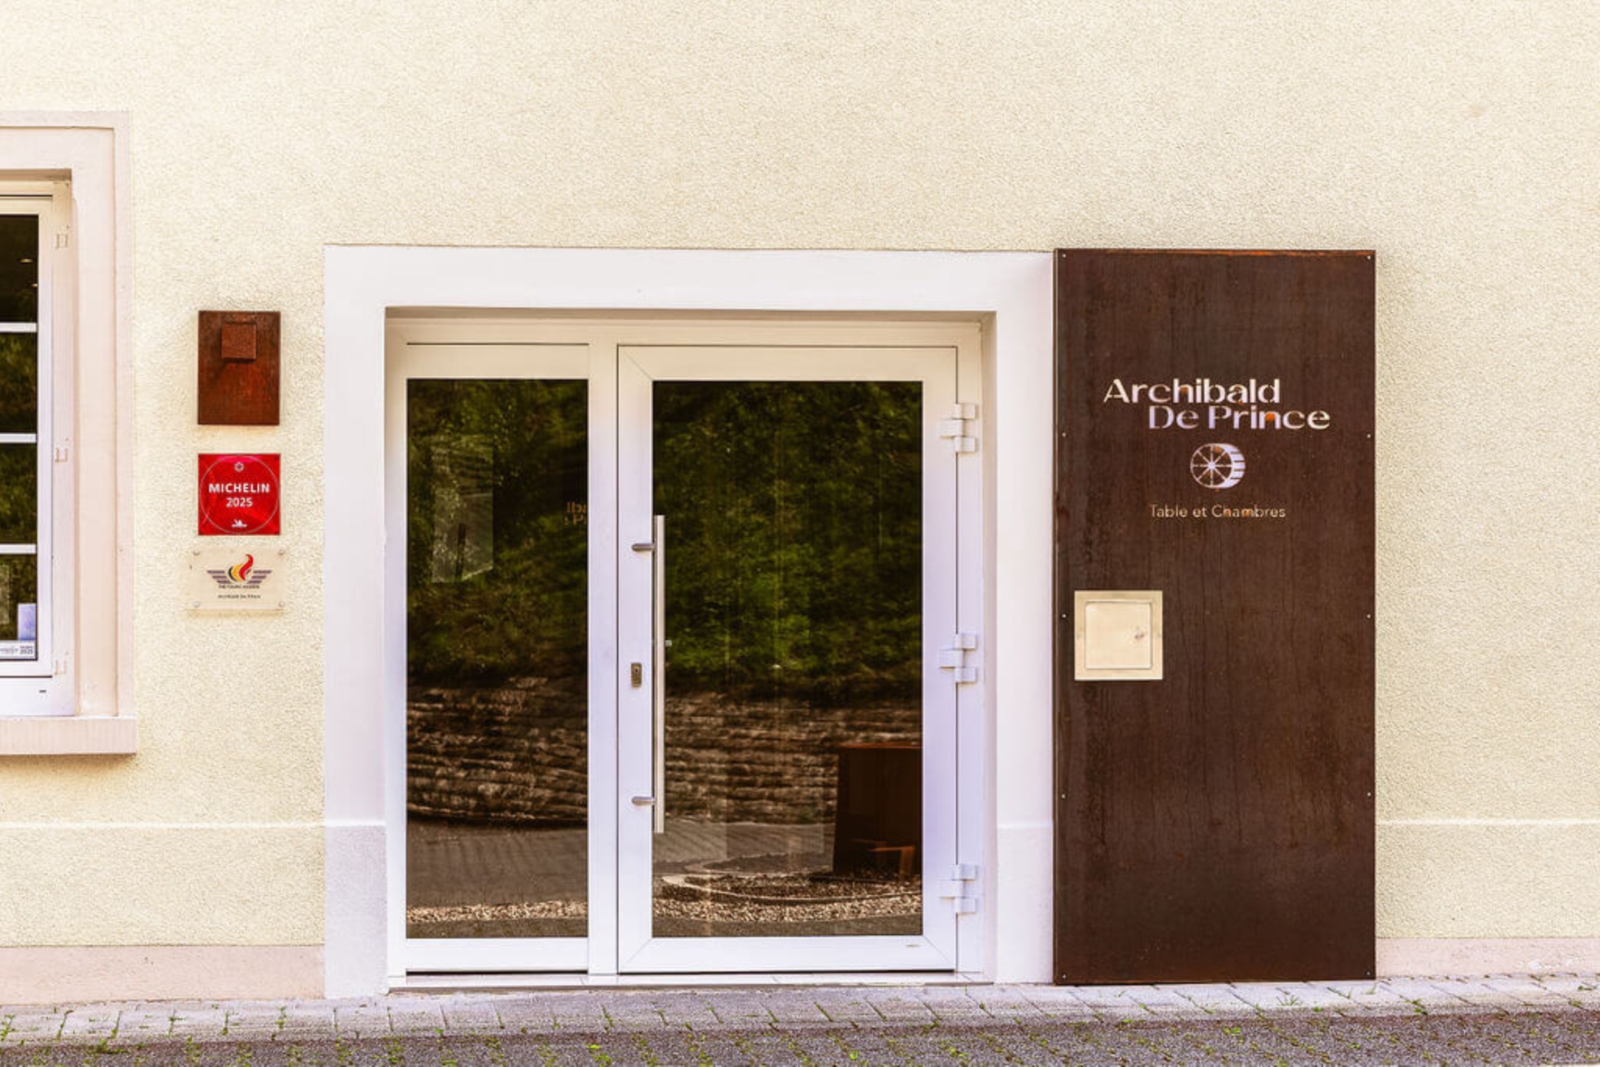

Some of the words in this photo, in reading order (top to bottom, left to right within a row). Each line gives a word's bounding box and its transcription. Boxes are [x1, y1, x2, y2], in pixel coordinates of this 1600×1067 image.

[1103, 378, 1281, 404] Archibald
[1149, 405, 1199, 430] De
[1208, 405, 1331, 430] Prince
[208, 482, 271, 494] MICHELIN
[225, 496, 254, 508] 2025
[1150, 503, 1188, 518] Table
[1193, 505, 1207, 518] et
[1211, 503, 1286, 518] Chambres
